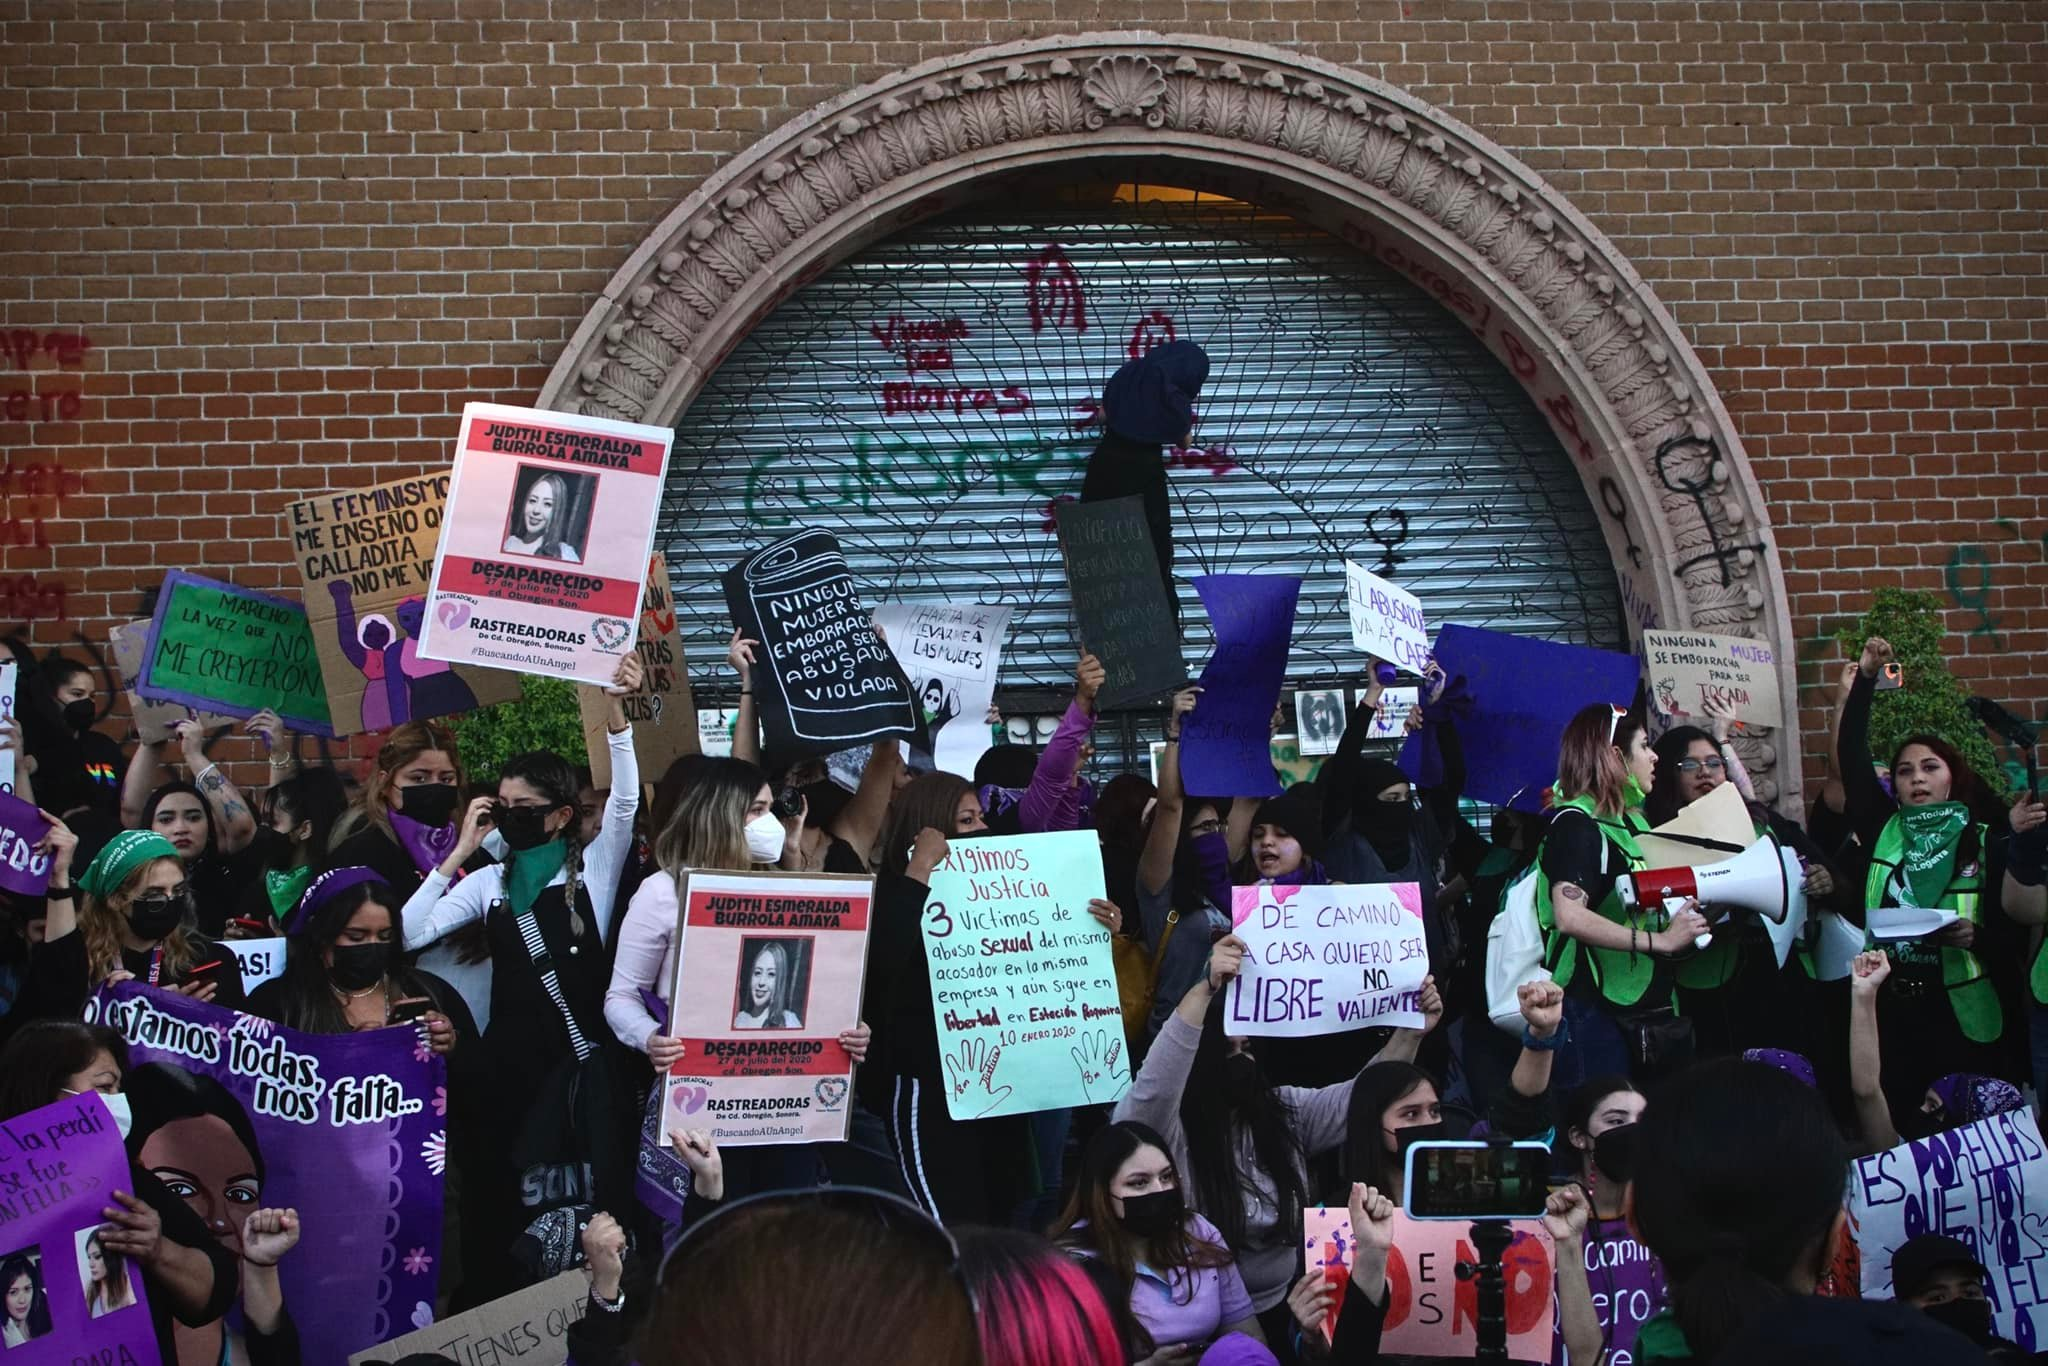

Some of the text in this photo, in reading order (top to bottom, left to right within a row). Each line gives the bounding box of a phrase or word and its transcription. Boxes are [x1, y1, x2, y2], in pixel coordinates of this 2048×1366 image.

[484, 424, 542, 442] JUDITH
[492, 438, 566, 459] BURROLA
[293, 475, 450, 525] EL FEMINISMO
[295, 527, 324, 551] ME
[306, 536, 418, 580] CALLADITA
[352, 564, 411, 595] NO ME
[501, 579, 514, 588] de
[516, 580, 539, 592] julio
[543, 584, 560, 595] del
[563, 589, 590, 599] 2020
[218, 593, 291, 625] MARCHO
[782, 599, 847, 636] MUJER
[182, 607, 310, 664] LA VEZ QUE NO
[470, 617, 587, 646] RASTREADORAS
[1352, 616, 1374, 636] VA
[471, 647, 577, 671] #BuscandoAUnAngel
[800, 639, 848, 666] PARA
[913, 637, 937, 660] LAS
[1649, 635, 1774, 664] NINGUNA MUJER
[1655, 651, 1669, 665] SE
[1672, 653, 1741, 670] EMBORRACHA
[156, 638, 323, 698] ME CREYERON
[1708, 669, 1752, 683] PARA SER
[804, 676, 899, 701] VIOLADA
[1696, 682, 1751, 706] TOCADA
[622, 694, 662, 726] AZIS?
[930, 845, 1030, 874] xigimos
[966, 874, 1050, 902] Justicia
[705, 896, 762, 912] JUDITH
[1262, 901, 1402, 930] DE CAMINO
[714, 911, 785, 927] BURROLA
[926, 901, 953, 938] 3
[1051, 903, 1073, 922] de
[932, 942, 976, 961] abuso
[1039, 931, 1059, 949] del
[1063, 933, 1111, 948] mismo
[1265, 941, 1315, 965] CASA
[1323, 940, 1393, 965] QUIERO
[1399, 937, 1426, 962] SER
[237, 952, 271, 977] AS!
[936, 955, 1089, 981] acosador en la misma
[1363, 967, 1390, 991] NO
[938, 986, 999, 1008] empresa
[1006, 984, 1015, 999] y
[1093, 978, 1112, 989] en
[1233, 974, 1324, 1023] LIBRE
[1337, 990, 1424, 1022] VALIENTE
[1007, 1012, 1026, 1023] en
[108, 1000, 325, 1093] estamos todas,
[999, 1030, 1017, 1047] 10
[1051, 1025, 1077, 1039] 2020
[733, 1056, 745, 1065] de
[747, 1055, 768, 1066] julio
[772, 1054, 786, 1064] del
[789, 1055, 812, 1064] 2020
[258, 1077, 420, 1123] nos falta...
[707, 1096, 811, 1111] RASTREADORAS
[5, 1105, 105, 1152] la perdí
[1857, 1108, 2042, 1207] ES POR ELLAS
[21, 1181, 76, 1215] ELLA
[1904, 1164, 2026, 1240] QUE HOY
[439, 1320, 541, 1366] TIENES
